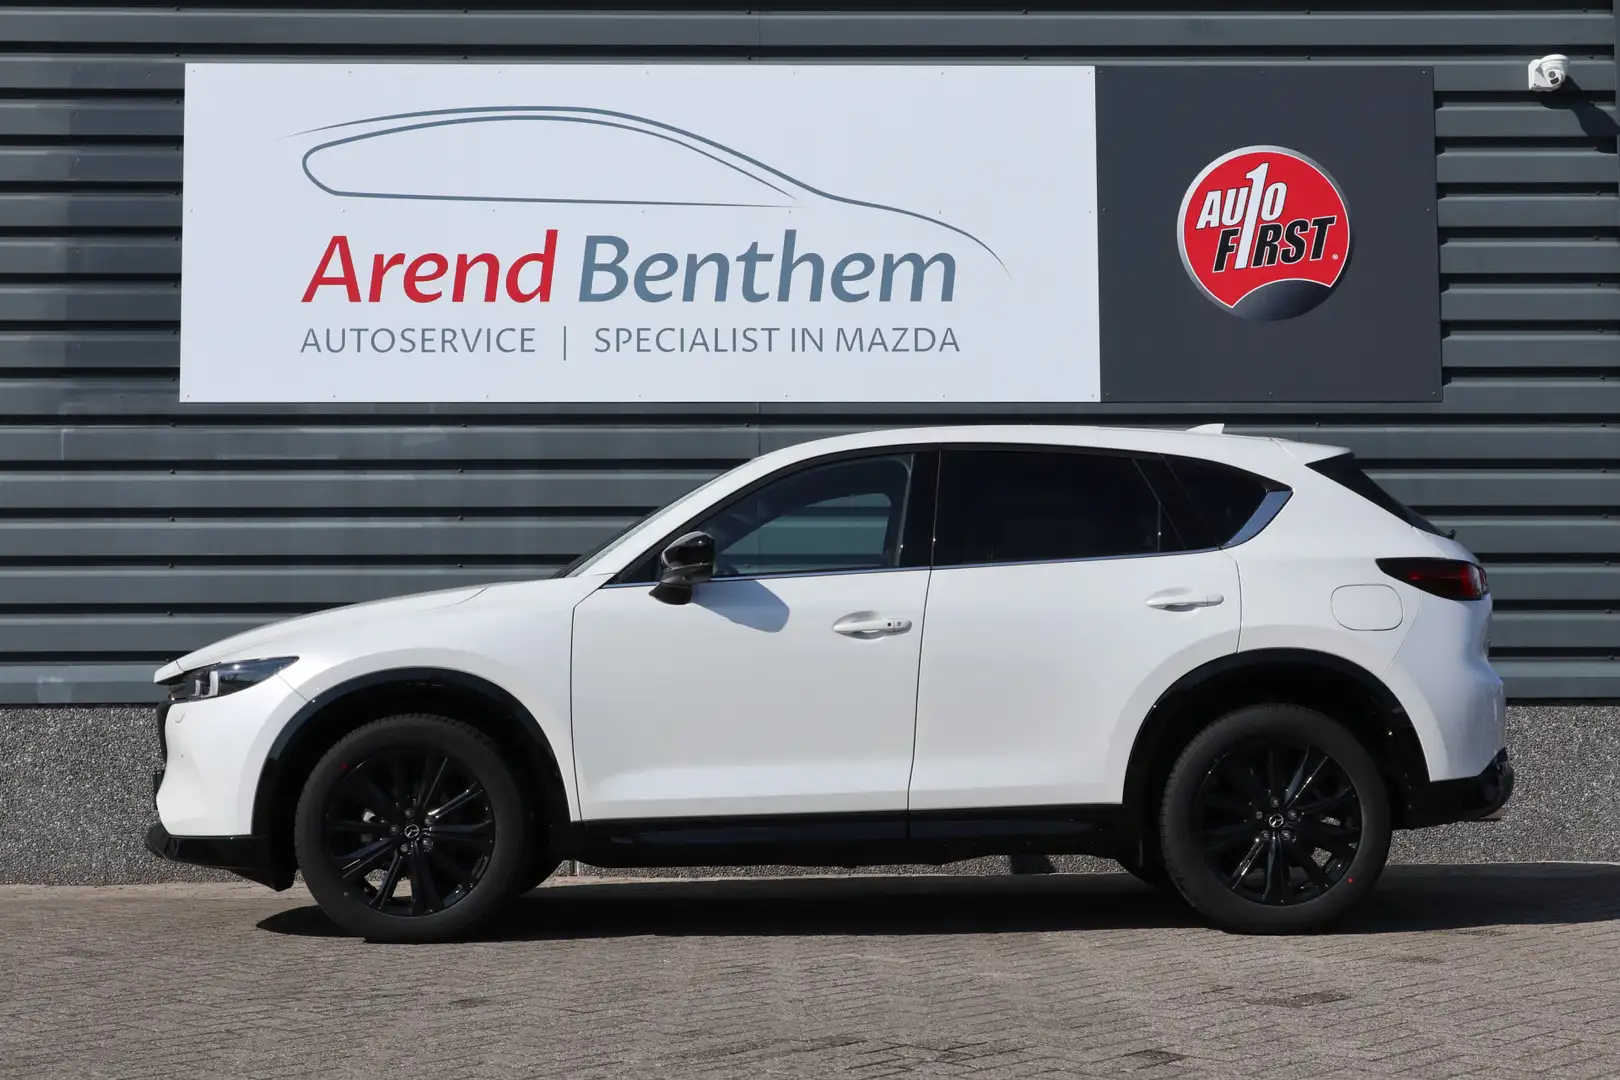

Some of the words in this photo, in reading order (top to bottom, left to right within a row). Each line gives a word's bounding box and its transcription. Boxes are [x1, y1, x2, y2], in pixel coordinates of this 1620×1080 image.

[301, 229, 558, 303] Arend
[579, 229, 956, 303] Benthem
[300, 327, 536, 354] AUTOSERVICE
[594, 327, 780, 353] SPECIALIST
[791, 327, 824, 353] IN
[835, 327, 961, 353] MAZDA
